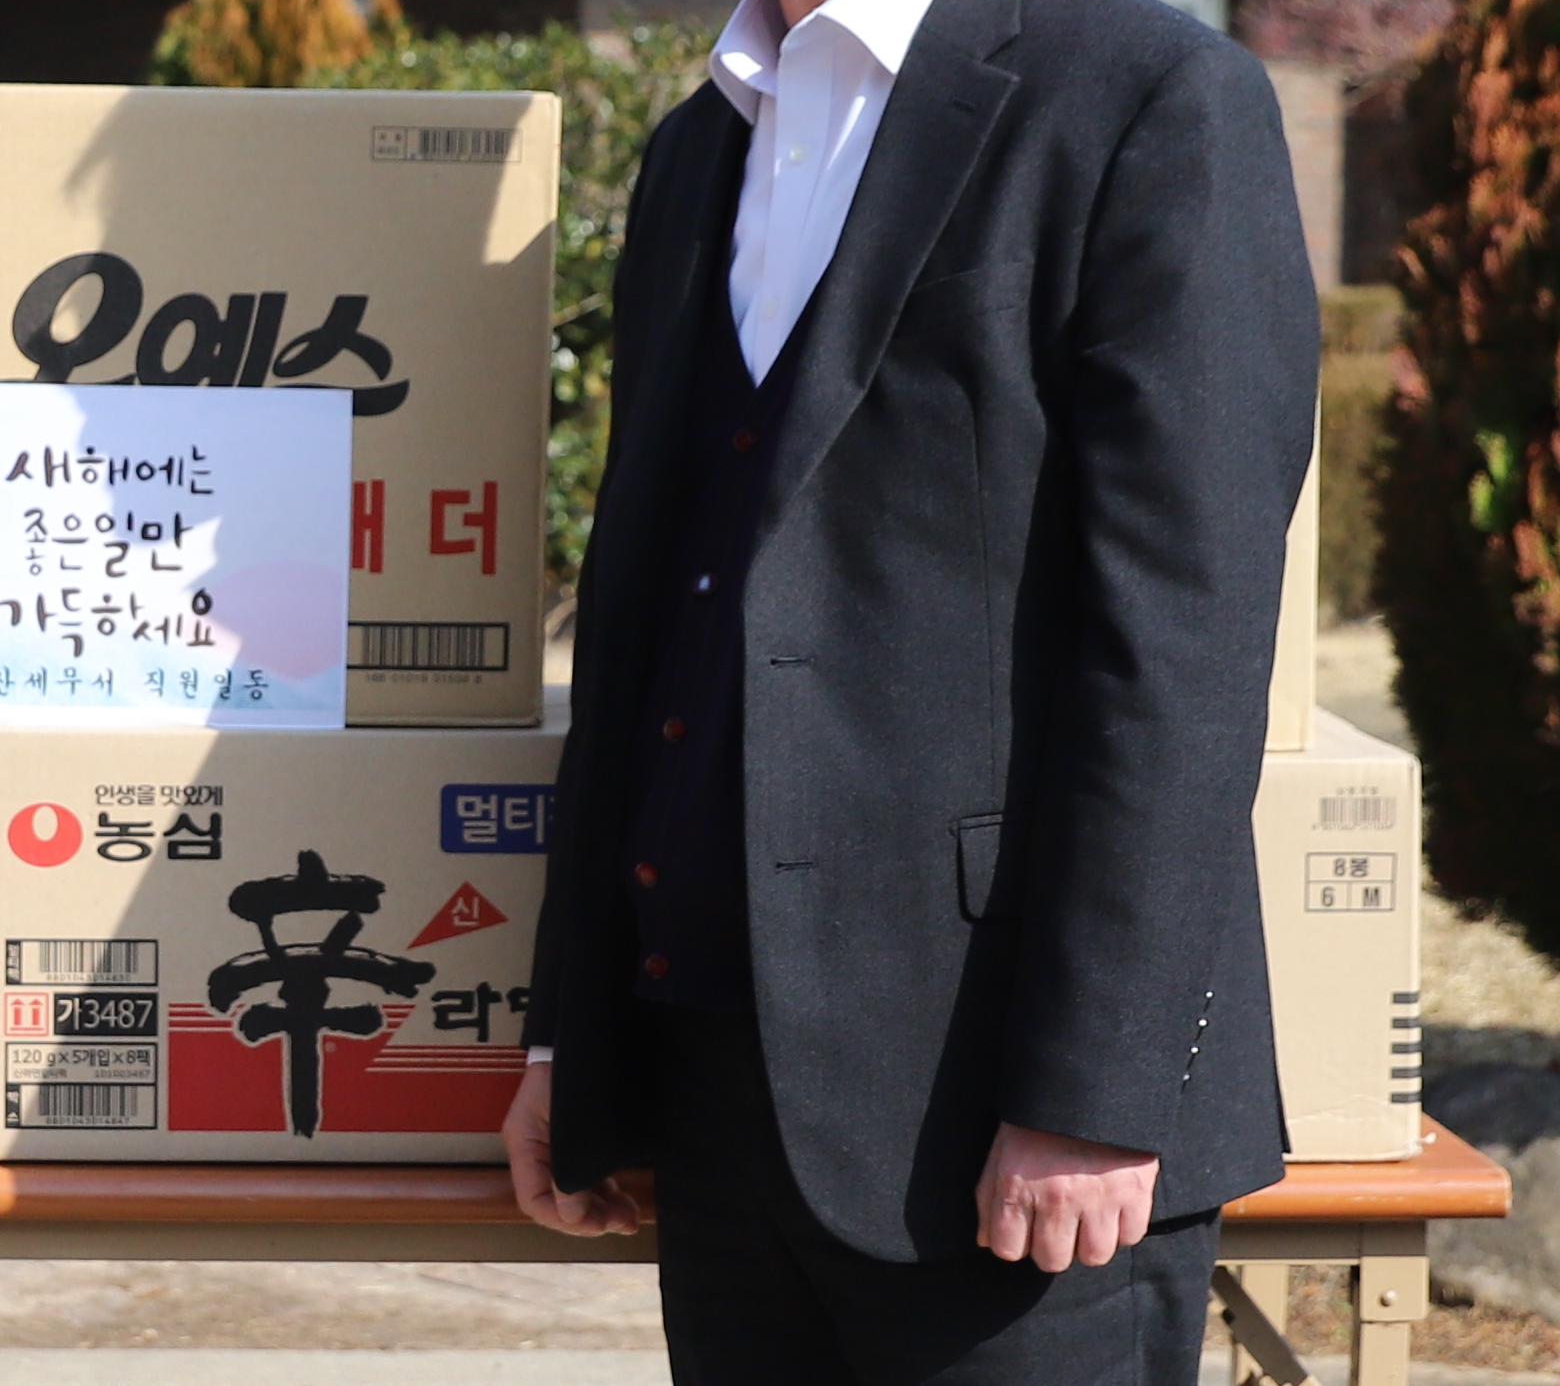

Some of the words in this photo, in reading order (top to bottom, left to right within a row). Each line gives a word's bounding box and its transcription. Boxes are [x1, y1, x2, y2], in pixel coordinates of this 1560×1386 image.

[5, 445, 215, 494] 새해에는
[144, 667, 269, 701] 직원일동
[95, 785, 156, 806] 인생을
[160, 785, 223, 806] 맛있게
[456, 794, 555, 844] 멀티
[94, 811, 222, 862] 농심
[452, 897, 479, 926] 신
[1322, 886, 1335, 907] 6
[206, 849, 435, 1139] 辛
[57, 997, 153, 1030] 가3487
